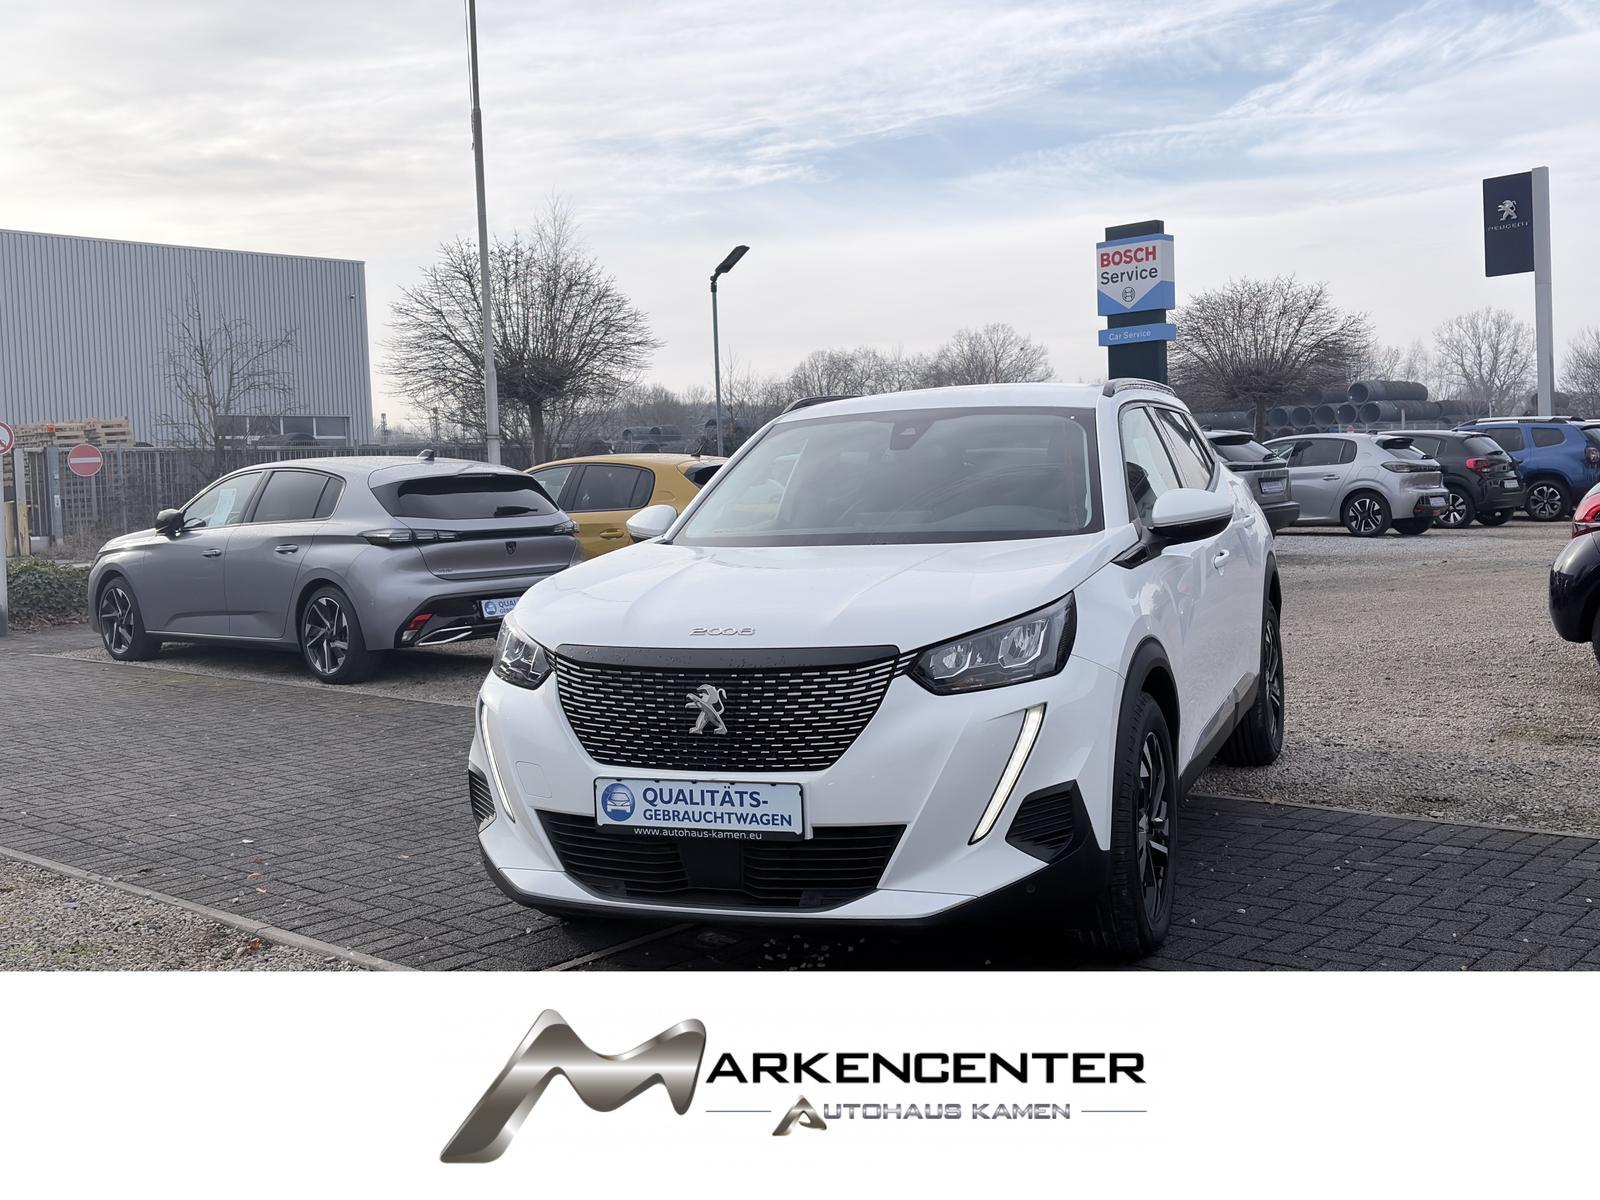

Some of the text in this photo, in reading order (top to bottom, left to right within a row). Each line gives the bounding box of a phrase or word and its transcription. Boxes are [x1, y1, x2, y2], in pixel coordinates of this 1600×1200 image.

[1100, 245, 1157, 268] BOSCH
[1100, 266, 1158, 285] Service
[1108, 329, 1151, 341] Car Service
[689, 627, 756, 636] 2008
[642, 786, 769, 808] QUALITÄTS-
[643, 808, 792, 827] GEBRAUCHTWAGEN
[633, 827, 763, 841] www.autohaus-kamen.eu
